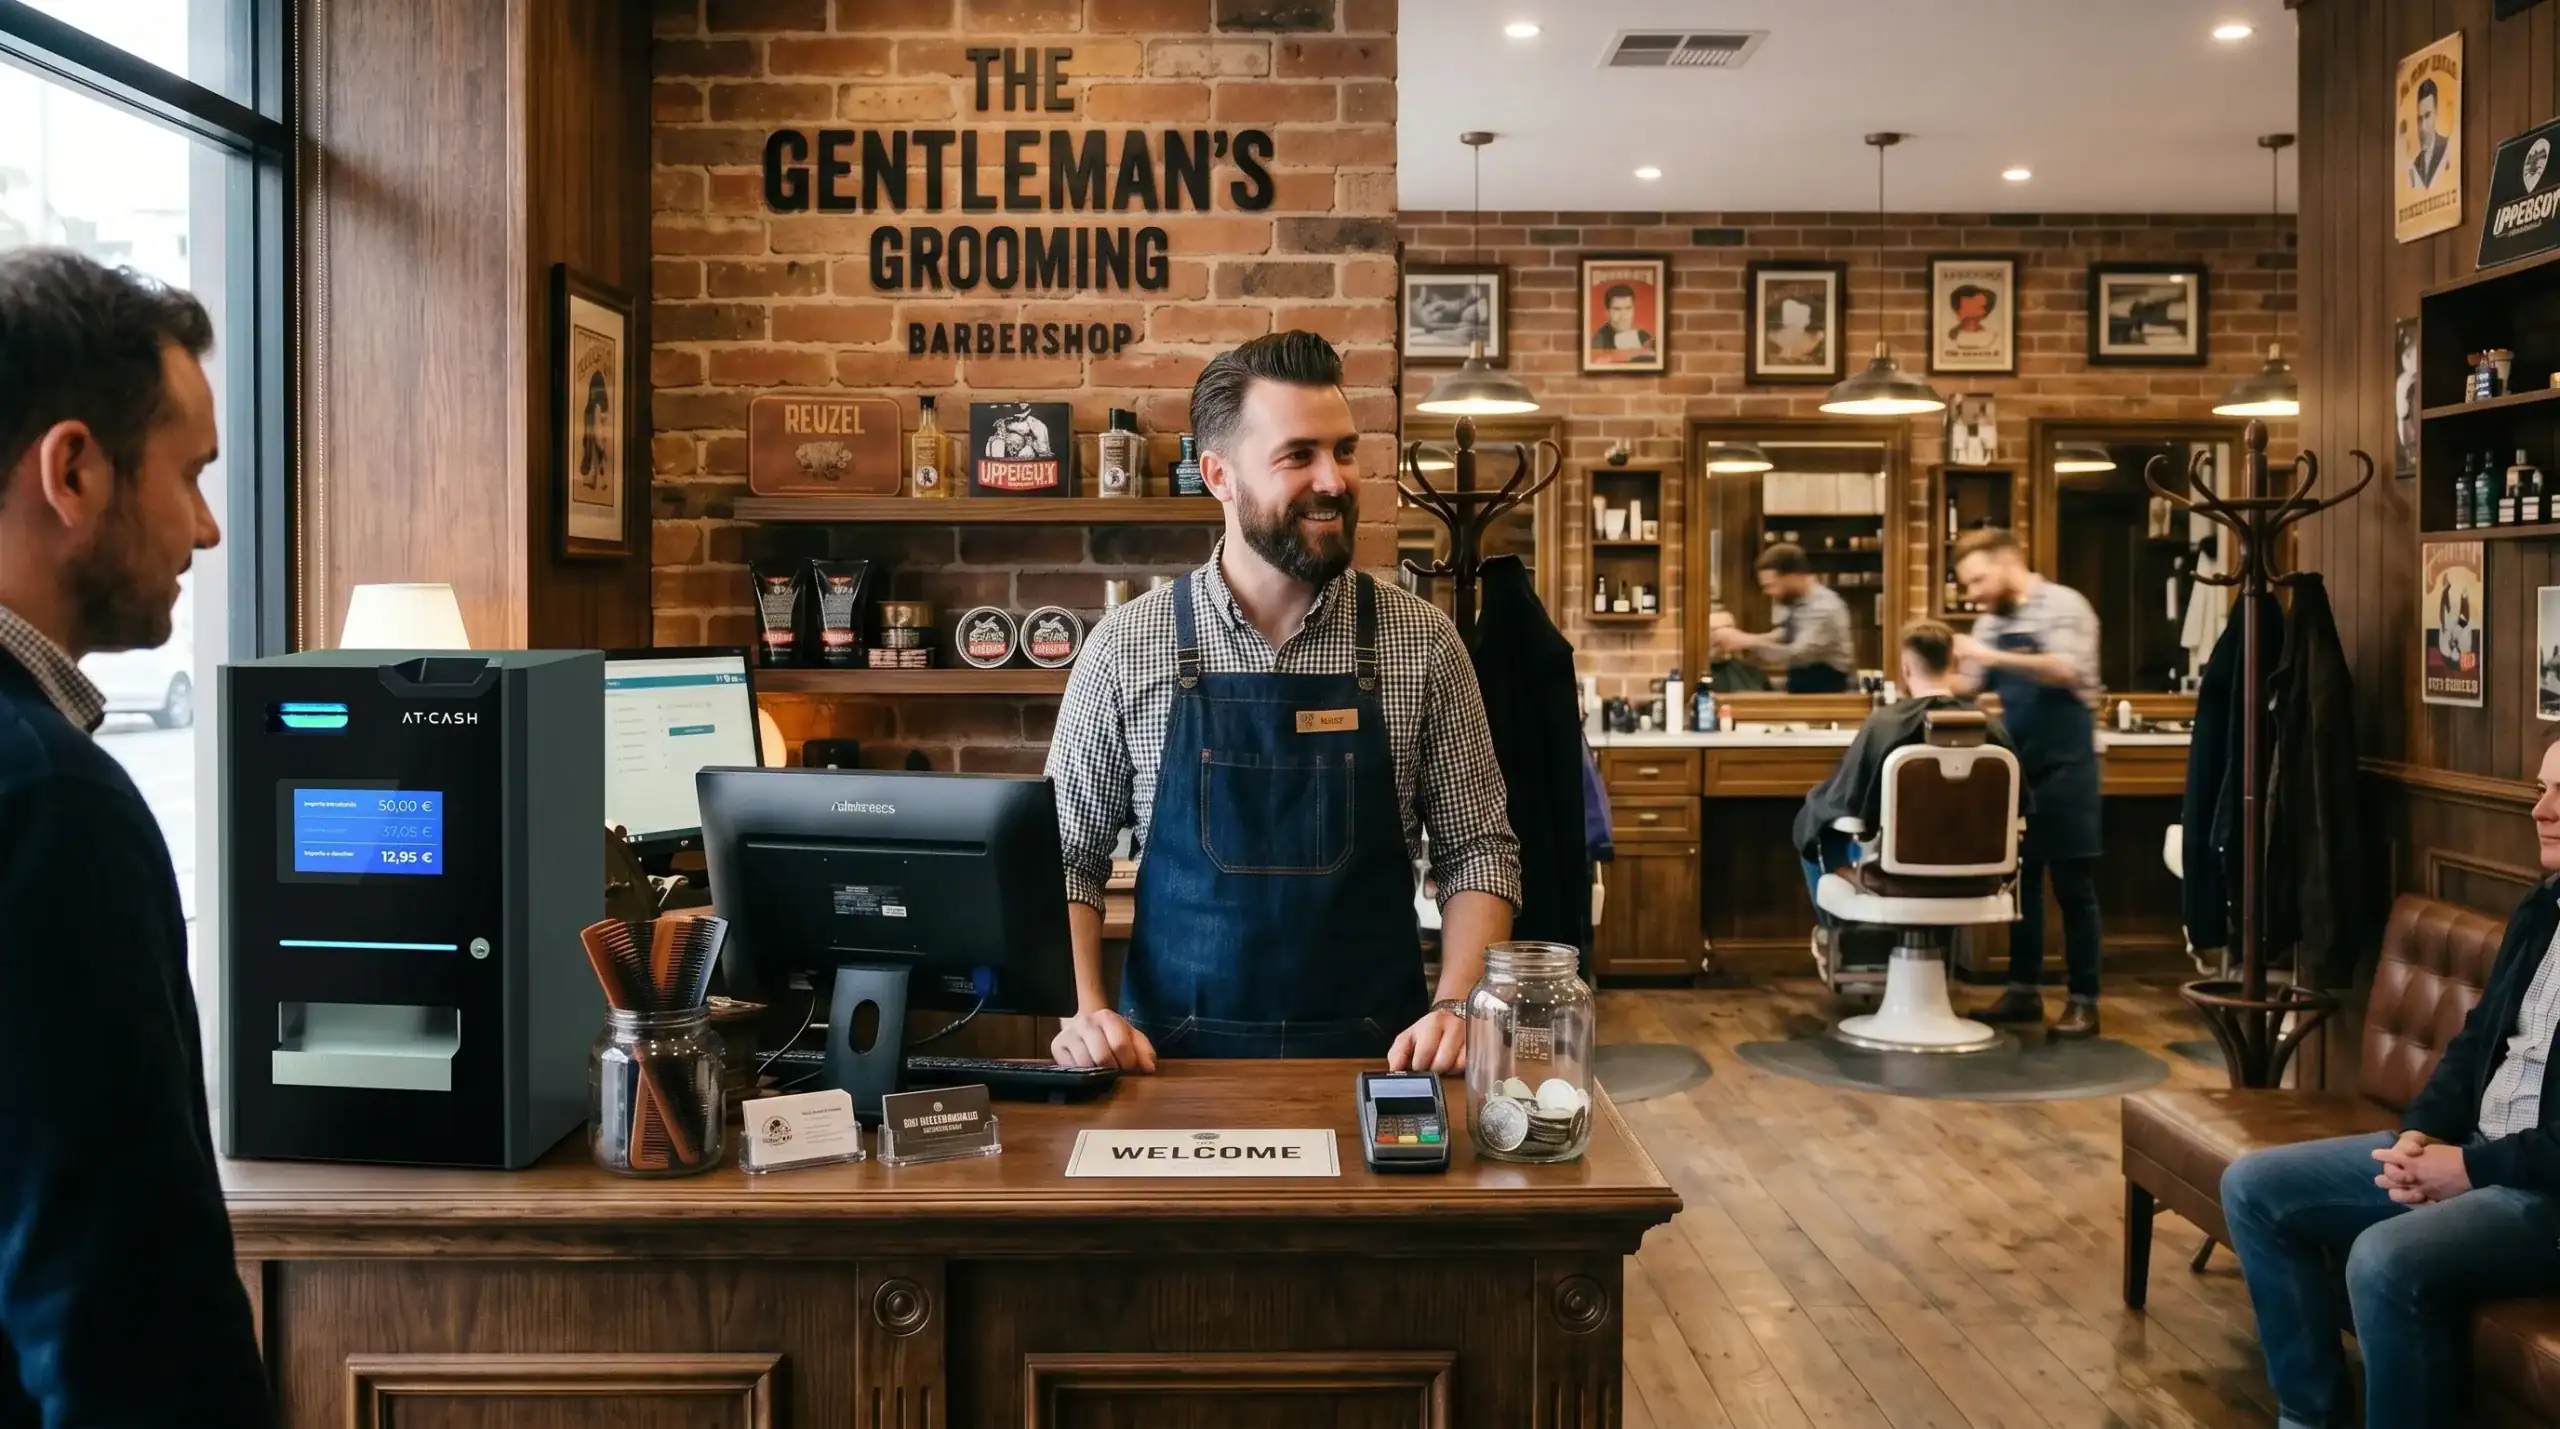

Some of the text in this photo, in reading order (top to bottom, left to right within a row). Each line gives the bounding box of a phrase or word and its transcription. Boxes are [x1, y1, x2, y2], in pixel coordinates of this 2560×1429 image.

[966, 47, 1075, 112] THE
[764, 129, 1276, 211] GENTLEMAN'S
[869, 226, 1170, 291] GROOMING
[908, 322, 1133, 355] BARBERSHOP
[784, 404, 866, 435] REUZEL
[379, 799, 417, 814] 50,00
[421, 800, 433, 812] €
[382, 825, 433, 838] 37,05 €
[381, 851, 417, 864] 12,95
[421, 852, 433, 863] €
[1111, 1146, 1301, 1160] WELCOME
